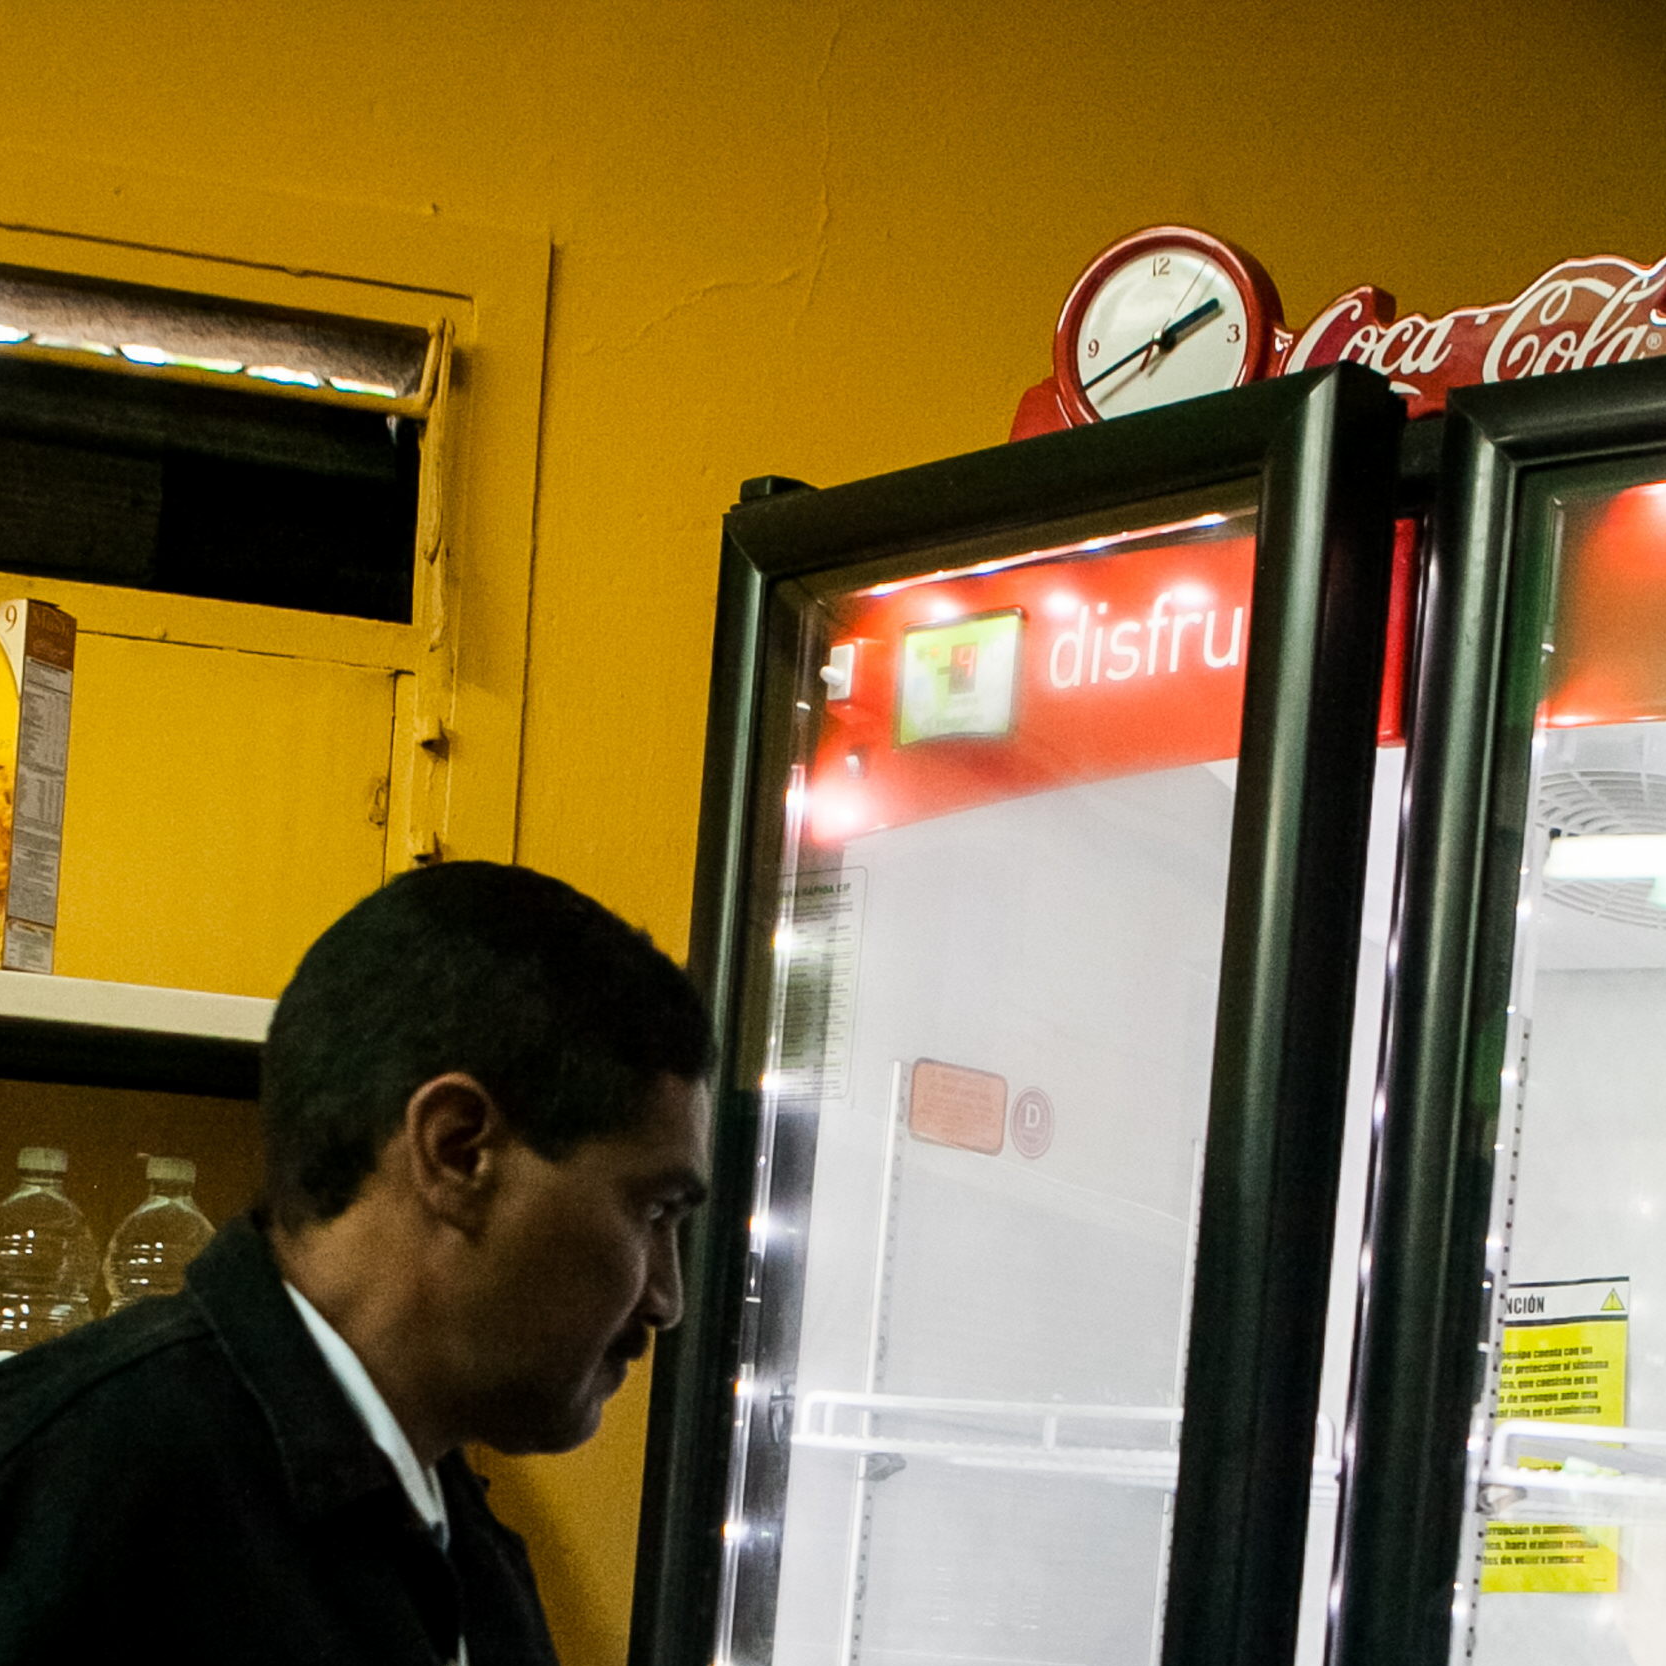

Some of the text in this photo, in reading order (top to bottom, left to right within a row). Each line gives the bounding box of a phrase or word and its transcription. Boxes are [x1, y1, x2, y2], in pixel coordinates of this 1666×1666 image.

[1150, 256, 1172, 277] 12
[1226, 323, 1241, 344] 3
[1087, 339, 1099, 358] 9
[5, 604, 18, 632] 9
[1049, 591, 1244, 689] disfru
